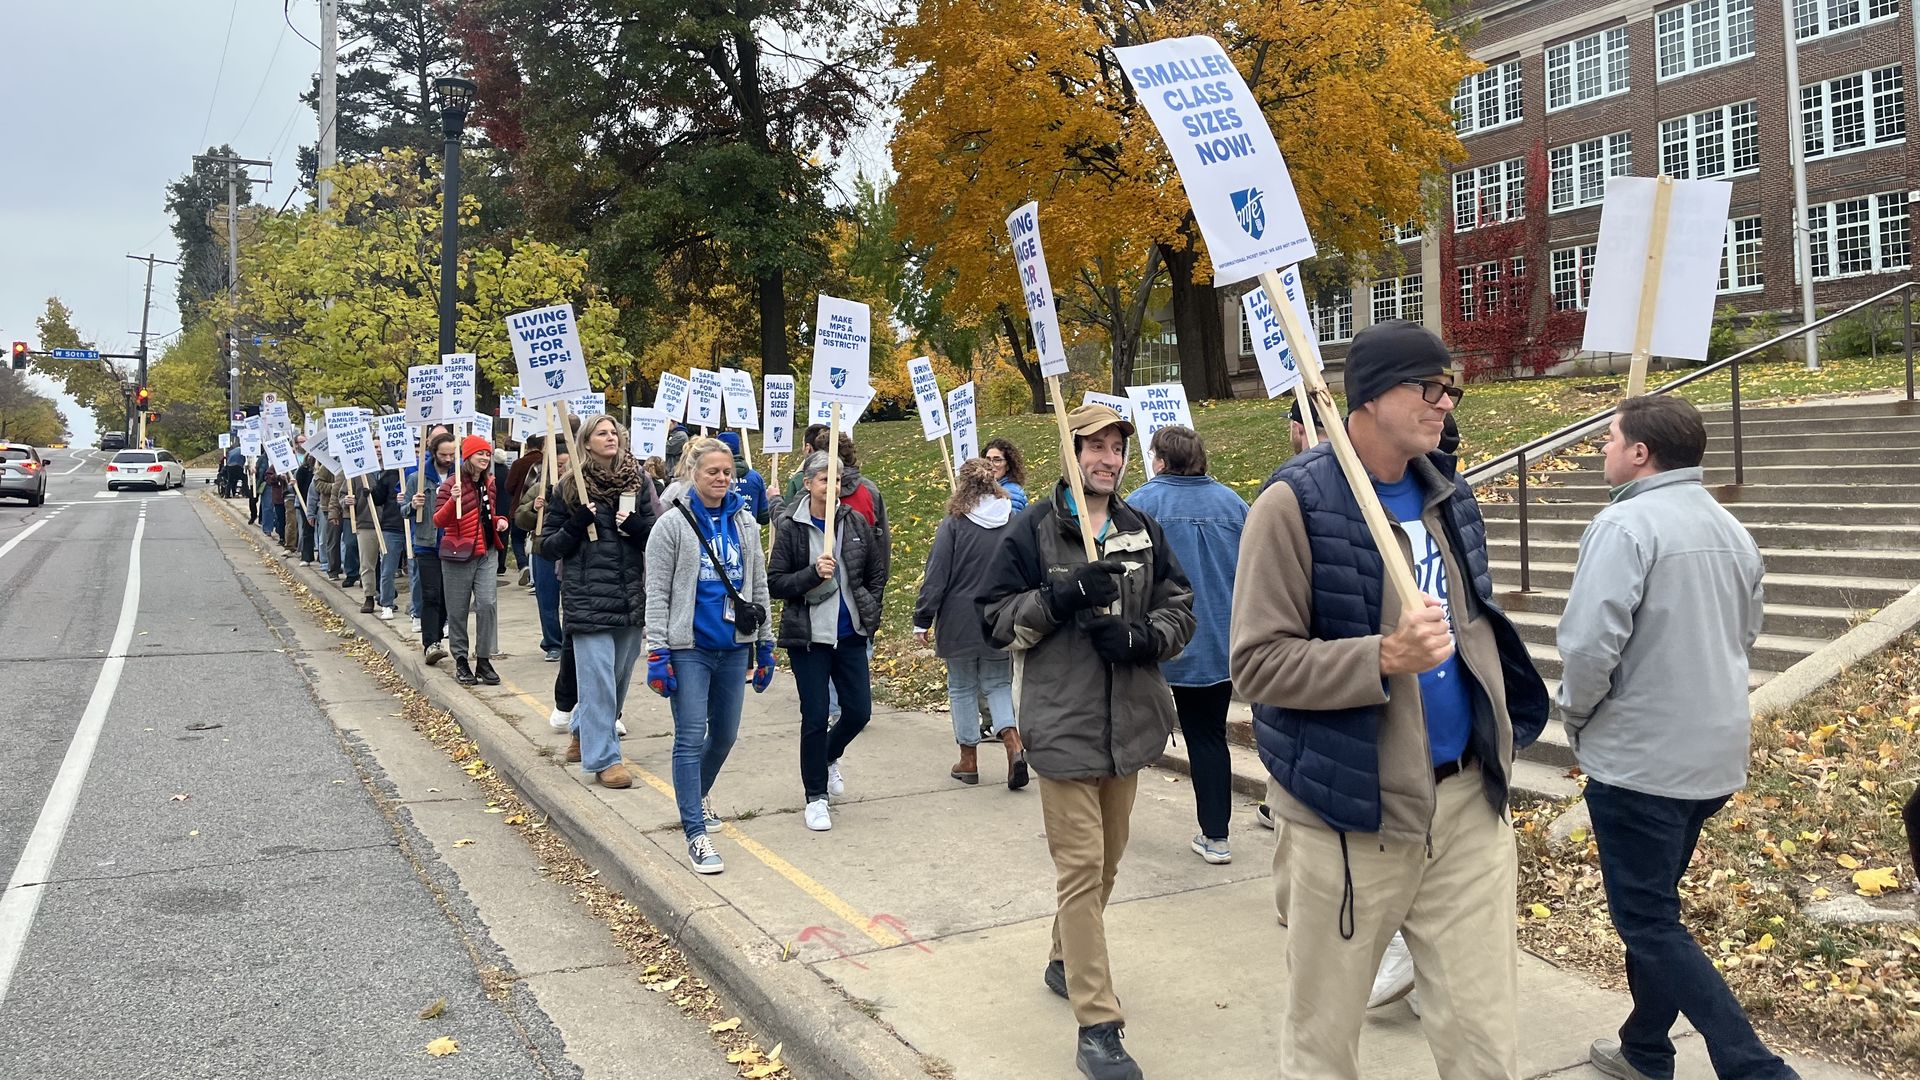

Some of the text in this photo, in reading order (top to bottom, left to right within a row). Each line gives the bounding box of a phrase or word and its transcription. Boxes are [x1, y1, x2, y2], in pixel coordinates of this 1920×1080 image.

[1131, 54, 1234, 89] SMALLER
[1163, 81, 1234, 112] CLASS
[1182, 107, 1243, 138] SIZES
[1194, 133, 1256, 166] NOW!
[1254, 288, 1295, 320] WE
[514, 310, 568, 330] LIVING
[831, 314, 853, 324] MAKE
[830, 322, 846, 331] MPS
[520, 324, 568, 342] WAGE
[818, 328, 866, 343] DESTINATION
[530, 338, 564, 354] FOR
[822, 338, 858, 350] DISTRICT!
[528, 350, 572, 368] ESPs!
[664, 374, 687, 387] LIVING
[692, 376, 721, 387] STAFFING
[766, 382, 793, 390] SMALLER
[664, 381, 684, 392] WAGE
[916, 384, 932, 394] BACK
[666, 388, 680, 397] FOR
[692, 390, 718, 399] SPECIAL
[954, 389, 967, 401] SAFE
[1147, 388, 1169, 399] PAY
[662, 394, 682, 404] ESPs!
[950, 396, 973, 412] STAFFING
[1140, 400, 1180, 410] PARITY
[818, 410, 846, 420] ESs!
[956, 409, 967, 419] FOR
[1153, 412, 1176, 422] FOR
[953, 416, 972, 431] SPECIAL
[336, 427, 367, 439] SMALLER
[342, 434, 364, 444] CLASS
[386, 439, 407, 448] ESPs!
[346, 446, 365, 454] NOW!
